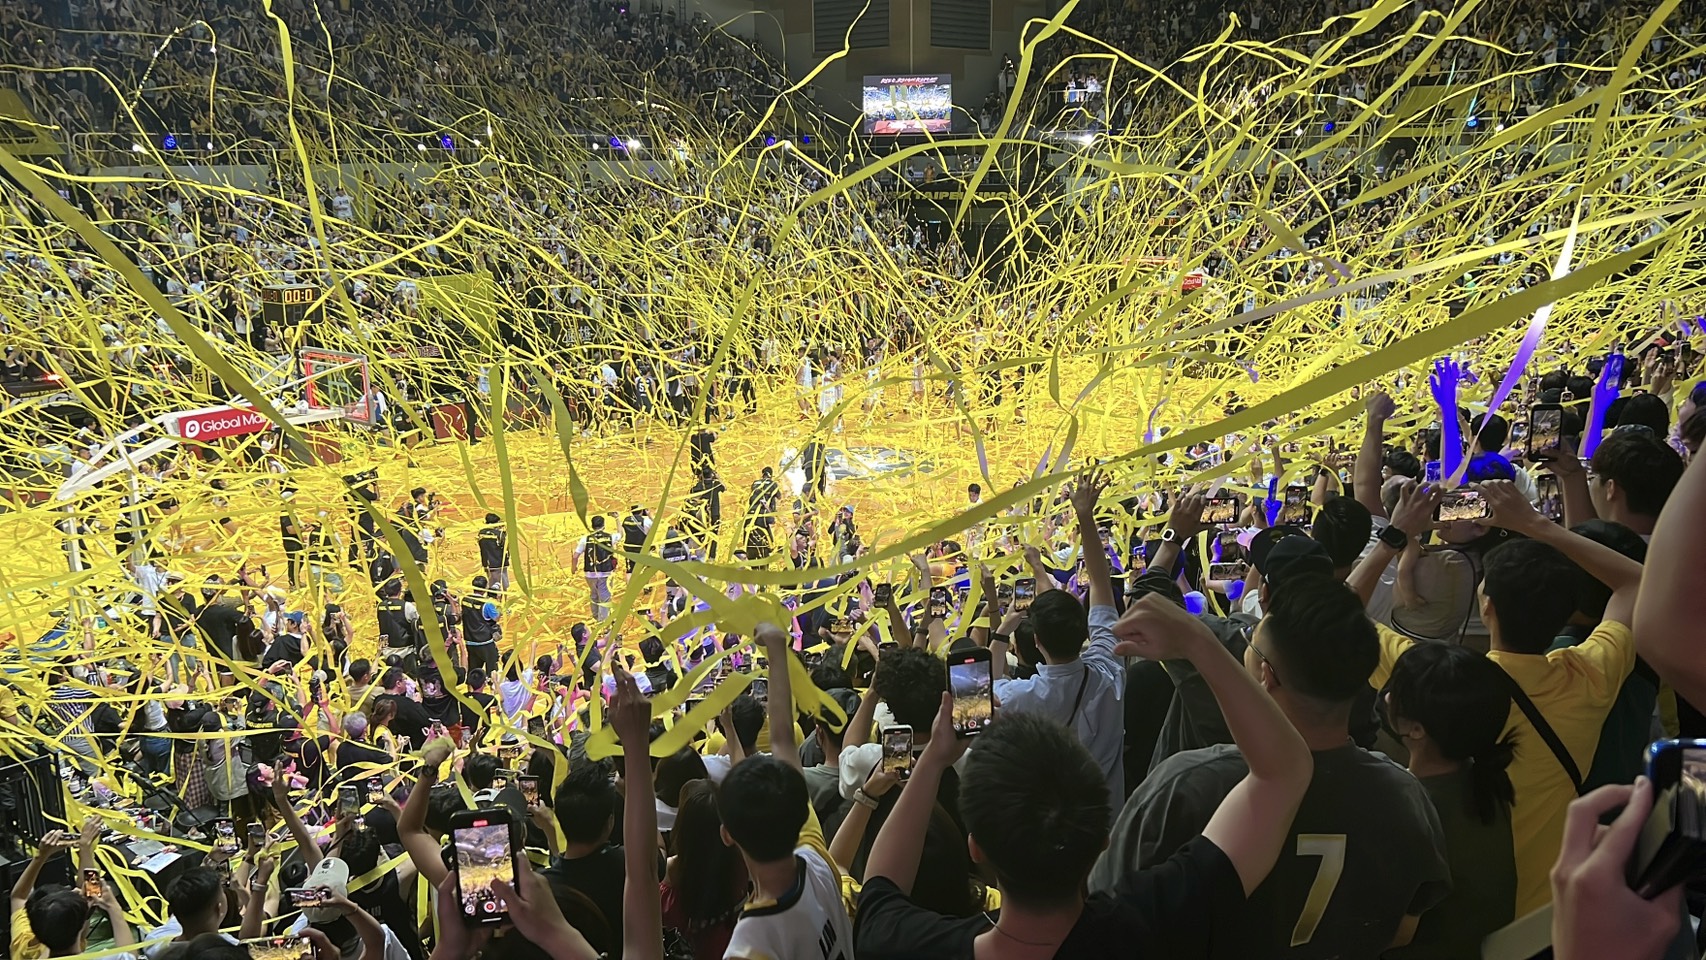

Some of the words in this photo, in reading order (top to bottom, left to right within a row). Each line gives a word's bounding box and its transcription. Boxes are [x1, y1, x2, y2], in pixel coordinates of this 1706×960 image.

[194, 373, 203, 382] 25
[201, 415, 240, 433] Global
[1290, 833, 1347, 947] 7
